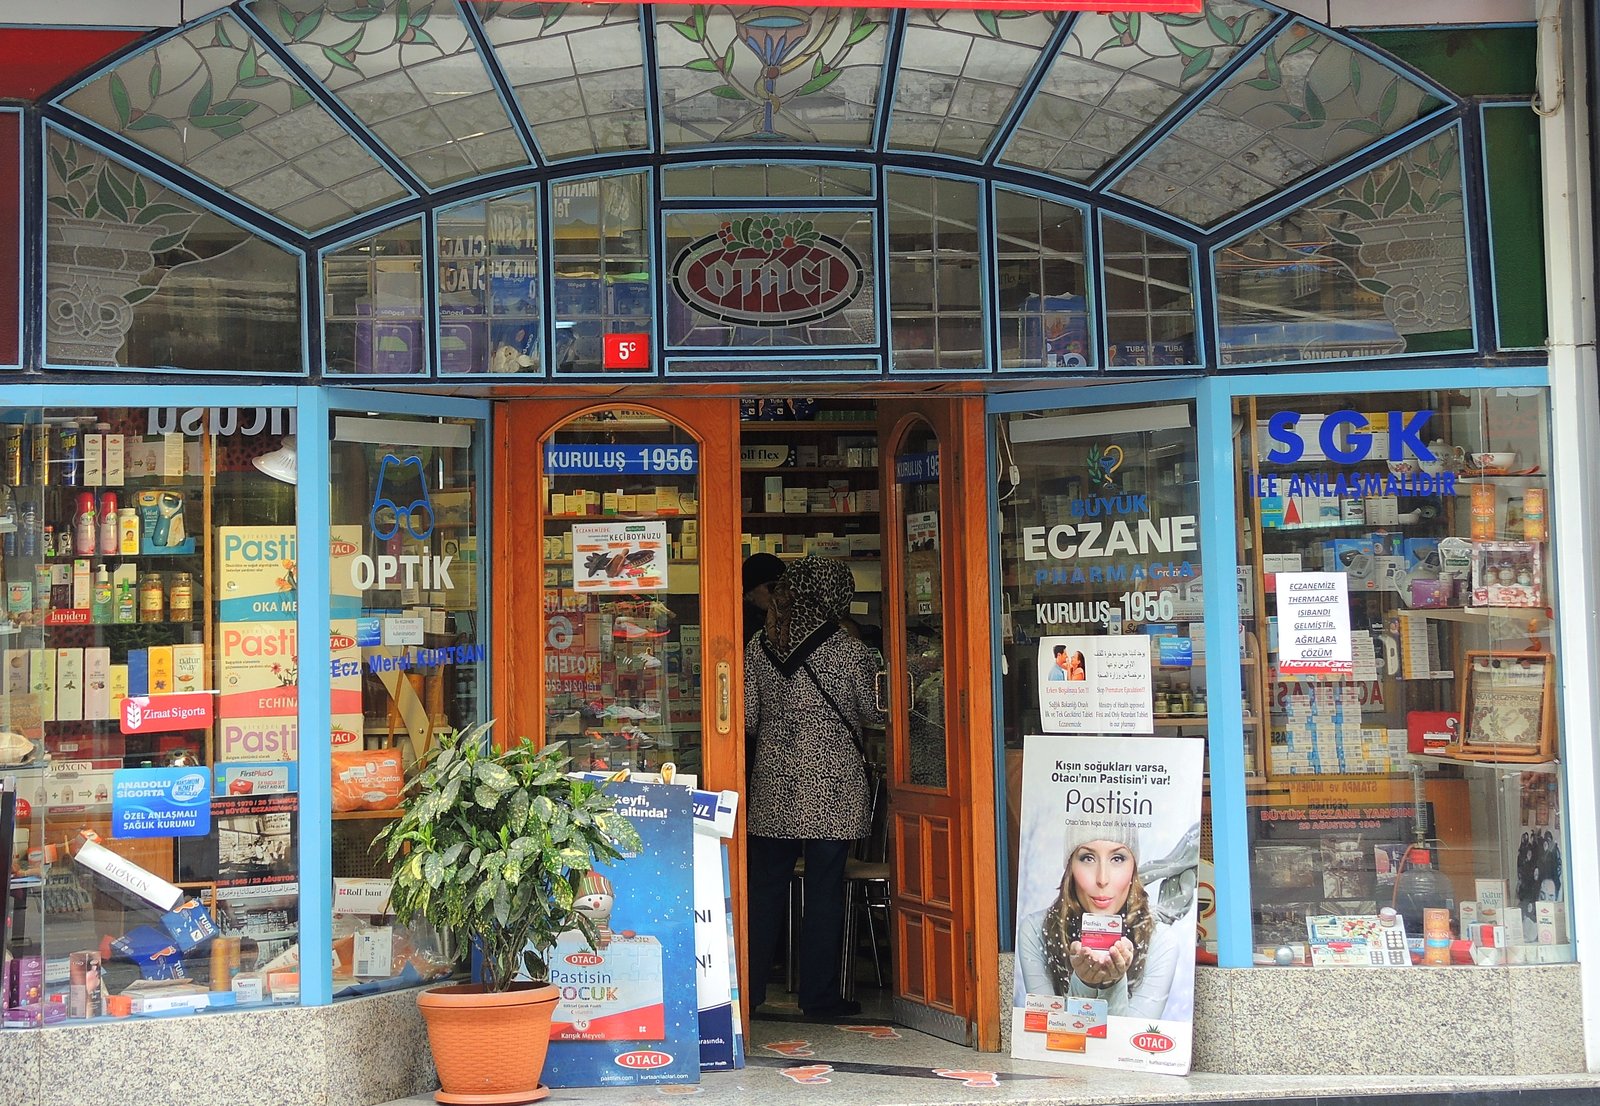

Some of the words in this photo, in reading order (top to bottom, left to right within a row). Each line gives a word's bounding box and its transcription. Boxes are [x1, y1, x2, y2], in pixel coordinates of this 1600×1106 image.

[1267, 409, 1437, 464] SGK
[549, 451, 625, 471] KURULUŞ
[638, 448, 693, 471] 1956
[897, 460, 922, 478] KURULUŞ
[1288, 472, 1456, 500] ANLAŞMALIDIR
[1071, 492, 1149, 517] BÜYÜK
[609, 533, 661, 541] KEÇİBOYNUZU
[1023, 515, 1197, 561] ECZANE
[225, 534, 295, 561] Pasti
[350, 546, 455, 590] OPTİK
[1036, 561, 1194, 585] PHARMACIA
[1289, 581, 1336, 590] ECZANEMİZE
[1288, 595, 1339, 603] THERMACARE
[253, 602, 278, 612] OKA
[1036, 601, 1110, 628] KURULUŞ
[1120, 591, 1173, 621] 1956
[51, 611, 87, 622] lapiden
[1294, 620, 1336, 630] GELMİŞTİR.
[224, 629, 295, 656] Pasti
[1295, 634, 1337, 644] AĞRILARA
[1301, 648, 1333, 658] ÇÖZÜM
[331, 658, 363, 678] Ecz.
[370, 651, 411, 673] Meral
[416, 644, 484, 667] KURTSAN
[1280, 660, 1352, 668] ThermaCare
[143, 707, 171, 719] Ziraat
[172, 706, 205, 718] Sigorta
[226, 724, 296, 752] Pasti
[1055, 761, 1081, 773] Kışın
[1084, 761, 1132, 773] soğukları
[1135, 763, 1167, 774] varsa,
[117, 781, 171, 789] ANADOLU
[1051, 773, 1097, 783] Otacı'nın
[1100, 773, 1148, 784] Pastisin'i
[1151, 775, 1171, 785] var!
[1066, 789, 1152, 815] Pastisin
[123, 811, 145, 820] ÖZEL
[148, 810, 197, 820] ANLAŞMALI
[620, 808, 668, 818] altında!
[1260, 808, 1307, 821] BÜYÜK
[1309, 808, 1361, 820] ECZANE
[123, 820, 154, 830] SAĞLIK
[157, 820, 195, 828] KURUMU
[1312, 819, 1356, 830] AĞUSTOS
[199, 913, 214, 935] TUBA
[571, 955, 597, 963] OTACI
[551, 970, 611, 984] Pastisin
[576, 1019, 587, 1028] +6
[582, 1032, 606, 1040] Meyveli
[1139, 1036, 1167, 1049] OTACI
[626, 1055, 662, 1065] OTACI
